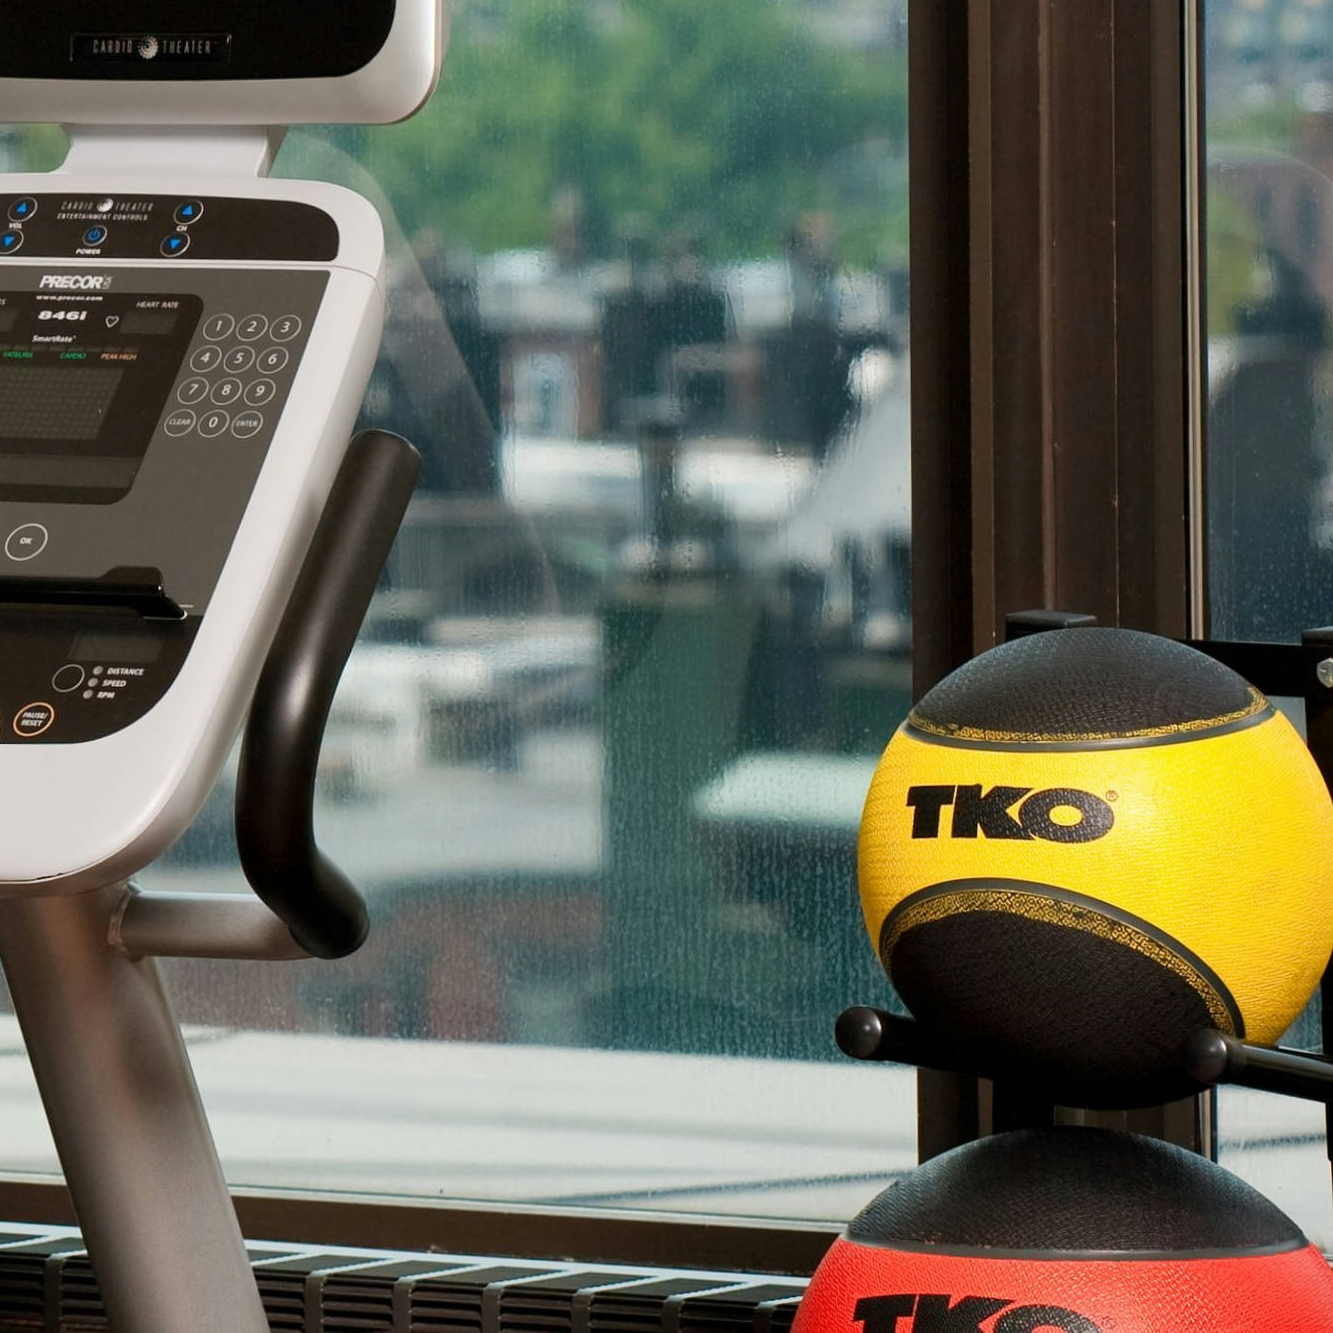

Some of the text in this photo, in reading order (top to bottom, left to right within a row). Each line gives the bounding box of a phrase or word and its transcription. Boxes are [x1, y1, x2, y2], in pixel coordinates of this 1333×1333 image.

[93, 40, 211, 54] CARDIO THEATER
[61, 202, 154, 212] CARDIO THEATER
[57, 212, 148, 222] ENTERTAINMENT CONTROLS
[39, 275, 104, 289] PRECOR
[136, 300, 180, 309] HEART RATE
[215, 320, 223, 332] 1
[247, 320, 257, 332] 2
[280, 322, 291, 333] 3
[33, 334, 73, 344] SmartRate
[201, 352, 211, 363] 4
[233, 352, 245, 364] 5
[267, 353, 278, 365] 6
[188, 384, 199, 396] 7
[221, 384, 232, 396] 8
[255, 385, 265, 397] 9
[169, 418, 191, 426] CLEAR
[208, 416, 219, 428] 0
[236, 420, 258, 428] ENTER
[19, 536, 33, 545] OK
[107, 667, 145, 676] DISTANCE
[102, 679, 127, 688] SPEED
[21, 712, 49, 720] PAUSE/
[21, 719, 44, 727] RESET
[906, 783, 1115, 844] TKO
